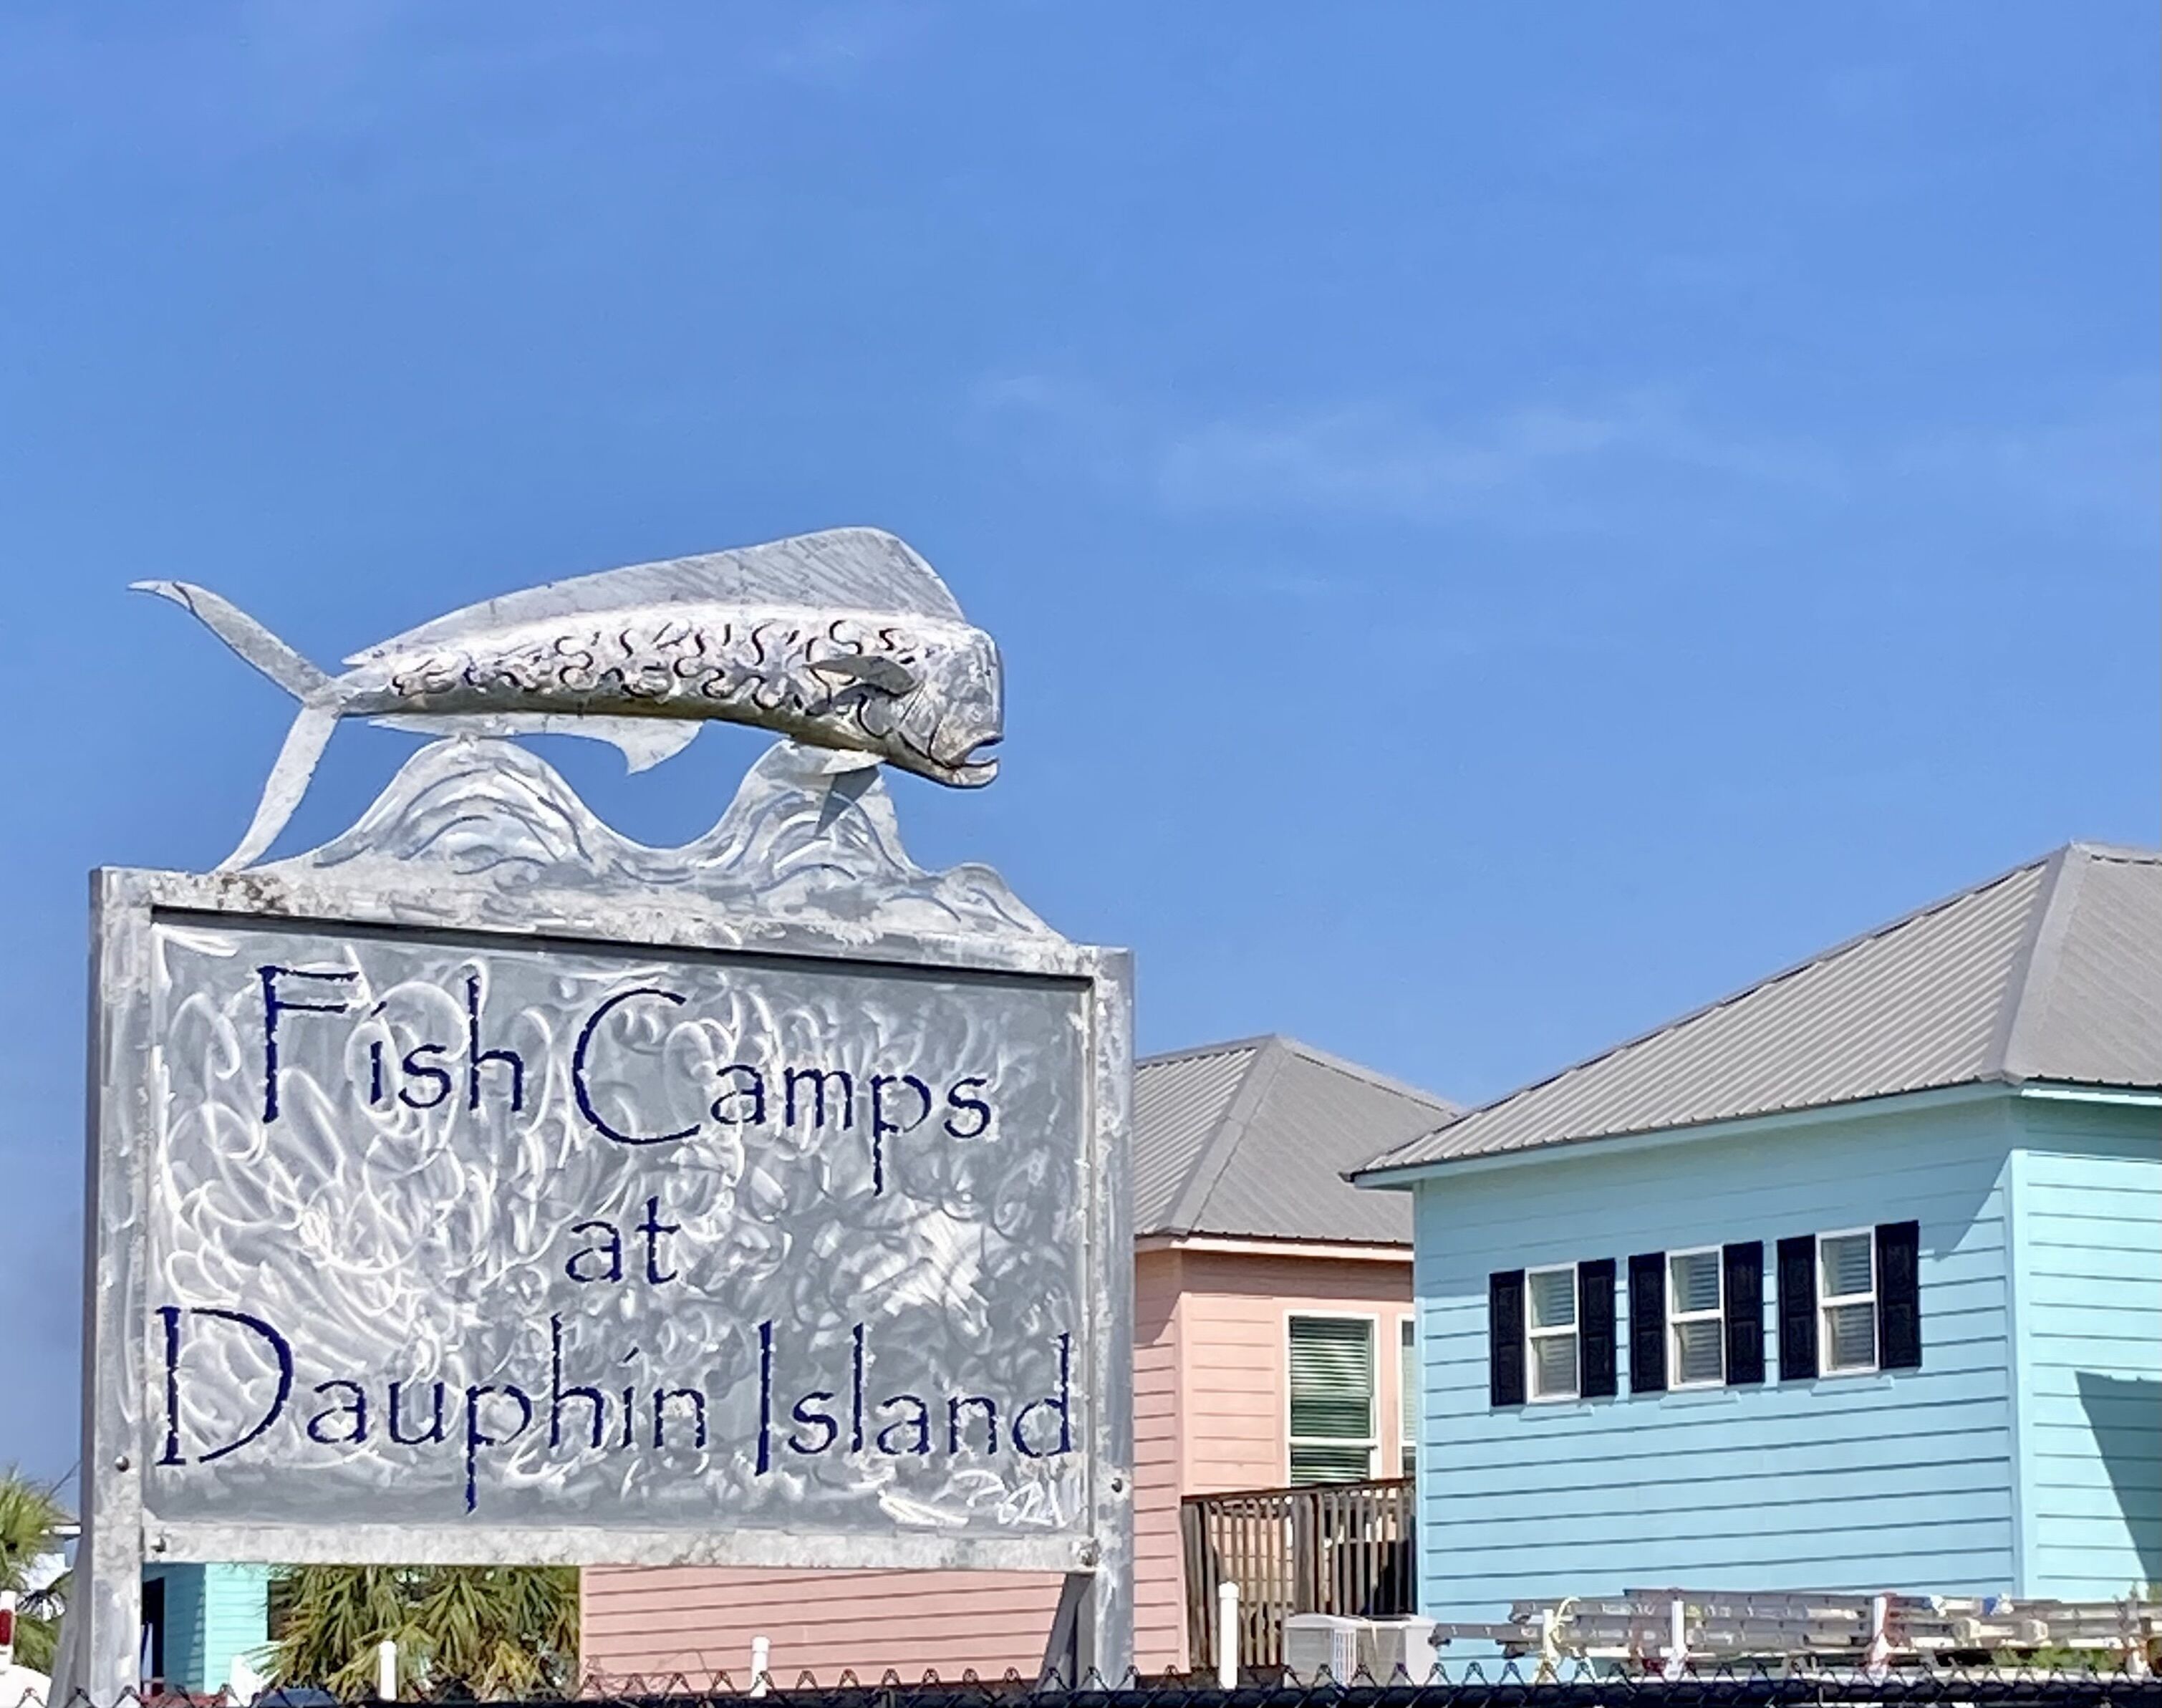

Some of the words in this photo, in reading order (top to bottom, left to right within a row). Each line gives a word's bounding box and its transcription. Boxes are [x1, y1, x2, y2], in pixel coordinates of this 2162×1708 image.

[257, 965, 524, 1124] Fish
[572, 988, 993, 1197] Camps
[564, 1195, 680, 1286] at
[155, 1306, 706, 1515] Dauphin
[755, 1319, 1072, 1476] Island
